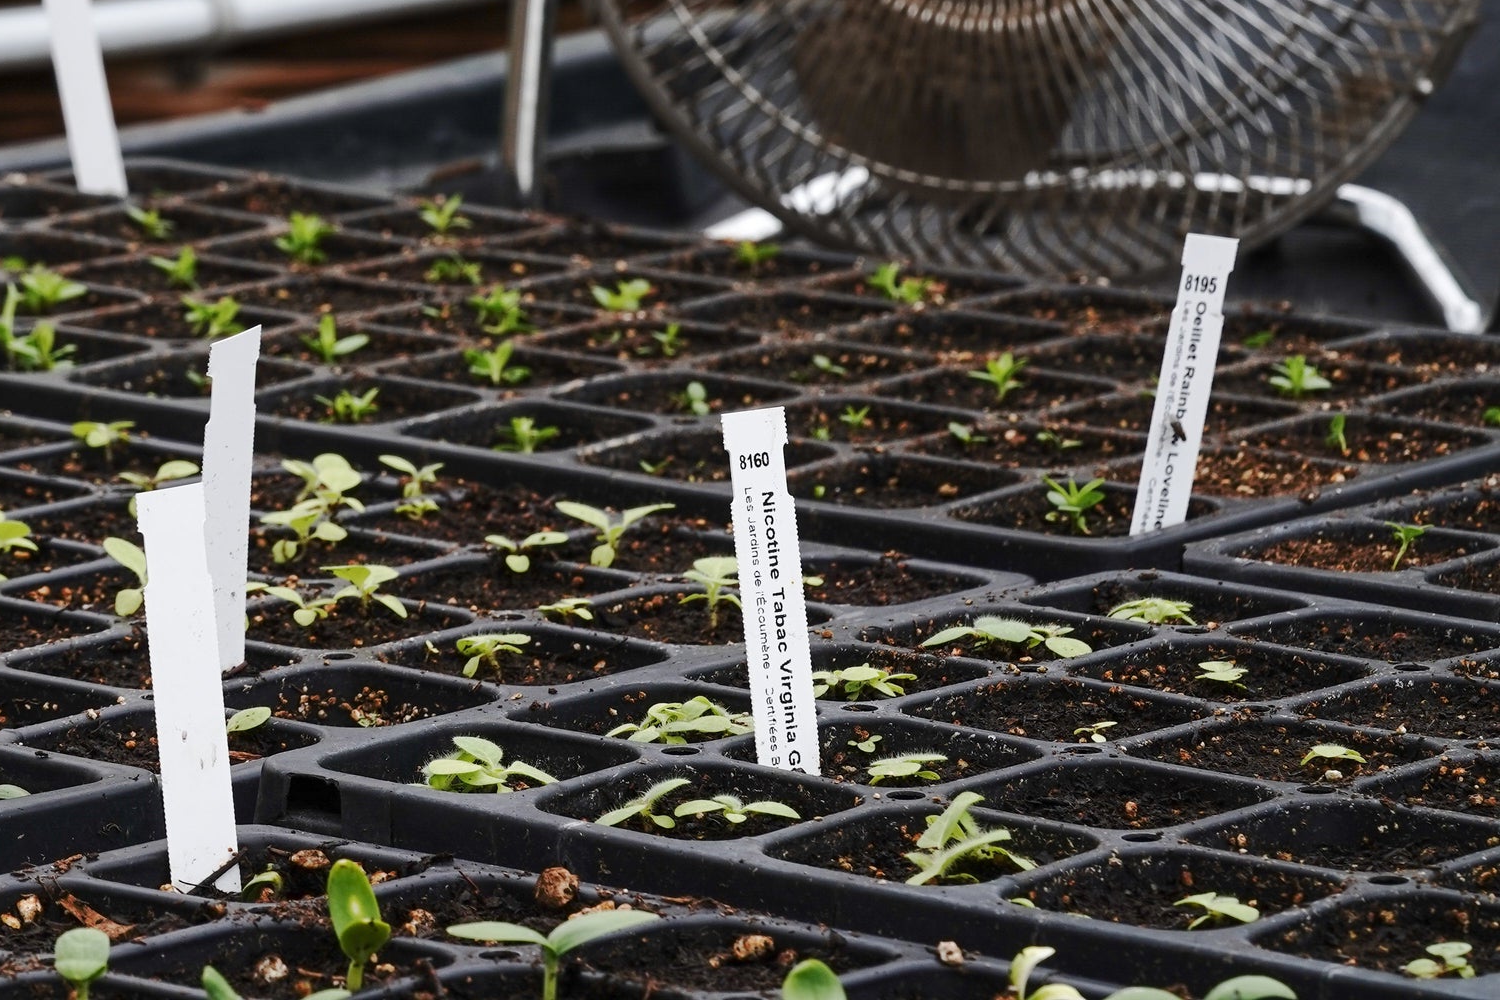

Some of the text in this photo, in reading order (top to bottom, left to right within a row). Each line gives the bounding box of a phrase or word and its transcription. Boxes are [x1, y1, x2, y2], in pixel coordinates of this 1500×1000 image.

[1185, 274, 1217, 293] 8195
[1187, 301, 1206, 360] Oeillet
[1171, 366, 1195, 447] Rainbw
[739, 452, 769, 470] 8160
[744, 487, 754, 512] Les
[748, 518, 760, 566] Jardins
[762, 491, 781, 580] Nicotine
[754, 571, 762, 587] de
[772, 587, 788, 653] Tabac
[779, 659, 798, 743] Virginia
